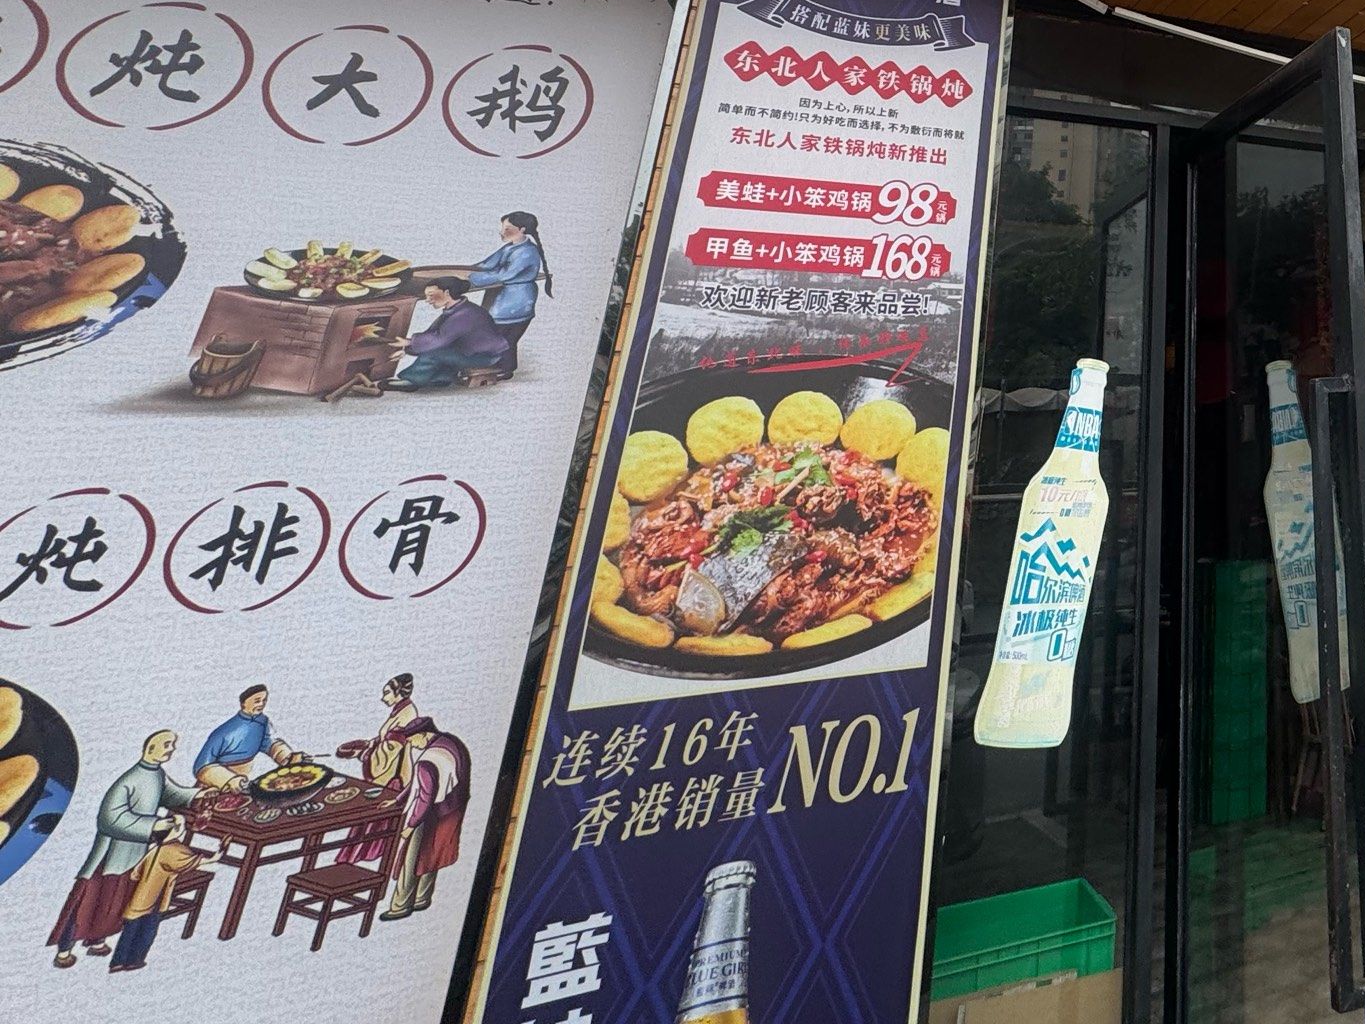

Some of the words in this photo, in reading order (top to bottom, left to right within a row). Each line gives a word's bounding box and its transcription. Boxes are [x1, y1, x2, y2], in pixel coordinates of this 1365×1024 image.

[789, 4, 932, 43] 搭配蓝妹更美味
[732, 47, 967, 101] 东北人家铁锅炖
[729, 126, 948, 166] 东北人家铁锅炖新推出
[715, 178, 873, 214] 美蛙+小笨鸡锅
[872, 179, 939, 226] 98
[705, 236, 865, 269] 甲鱼+小笨鸡锅
[861, 233, 933, 280] 168
[700, 285, 931, 318] 欢迎新老顾客来品尝!
[1075, 409, 1101, 437] NBA
[1011, 608, 1080, 639] 冰极纯生
[541, 709, 760, 789] 连续16年
[767, 708, 920, 814] NO.1
[570, 767, 768, 852] 香港销量
[519, 911, 614, 1024] 藍
